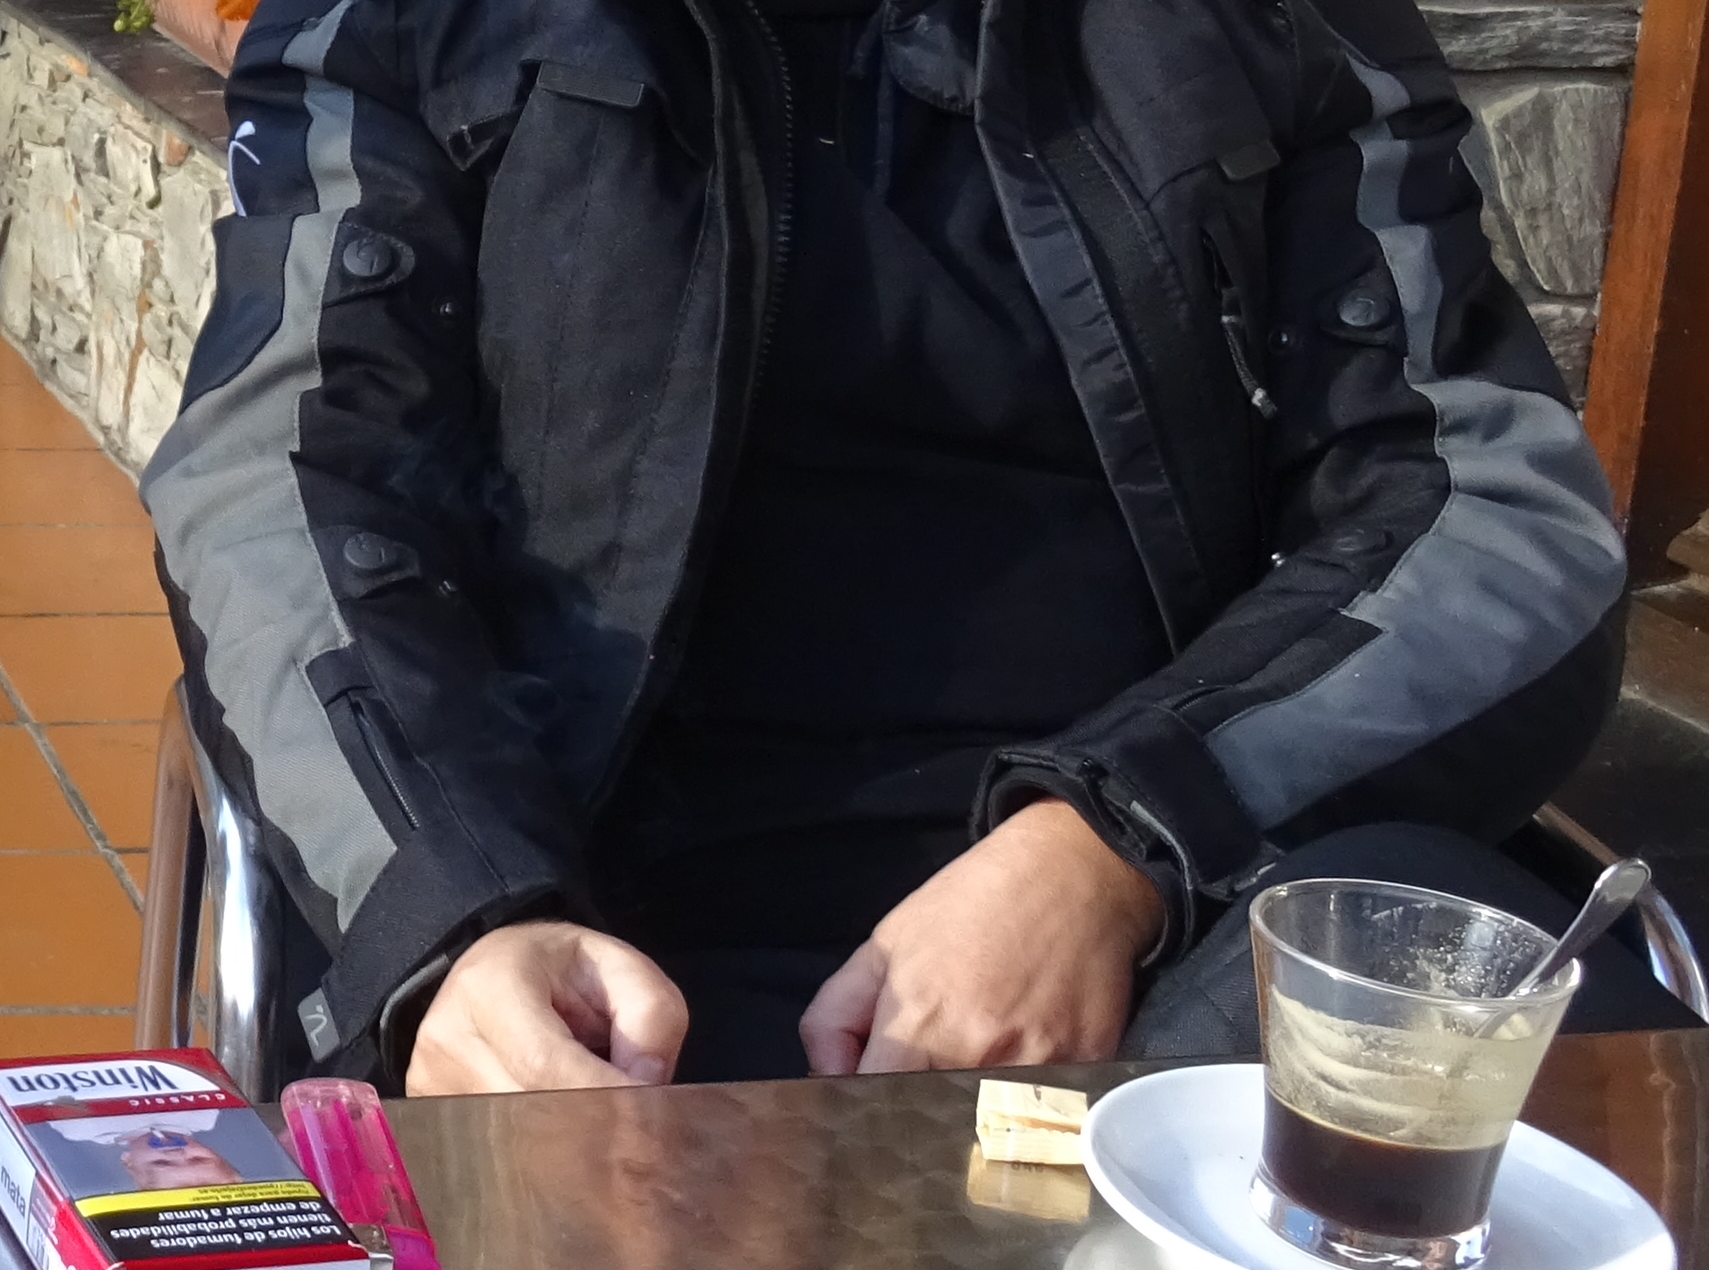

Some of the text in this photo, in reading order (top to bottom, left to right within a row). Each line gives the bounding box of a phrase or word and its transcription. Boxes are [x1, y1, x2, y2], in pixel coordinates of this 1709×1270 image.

[7, 1064, 180, 1093] Winston
[1, 1165, 26, 1218] mata
[158, 1200, 321, 1221] de empezar a fumar
[110, 1213, 332, 1238] tienen más probabilidades
[150, 1224, 342, 1248] Los hijos de fumadores
